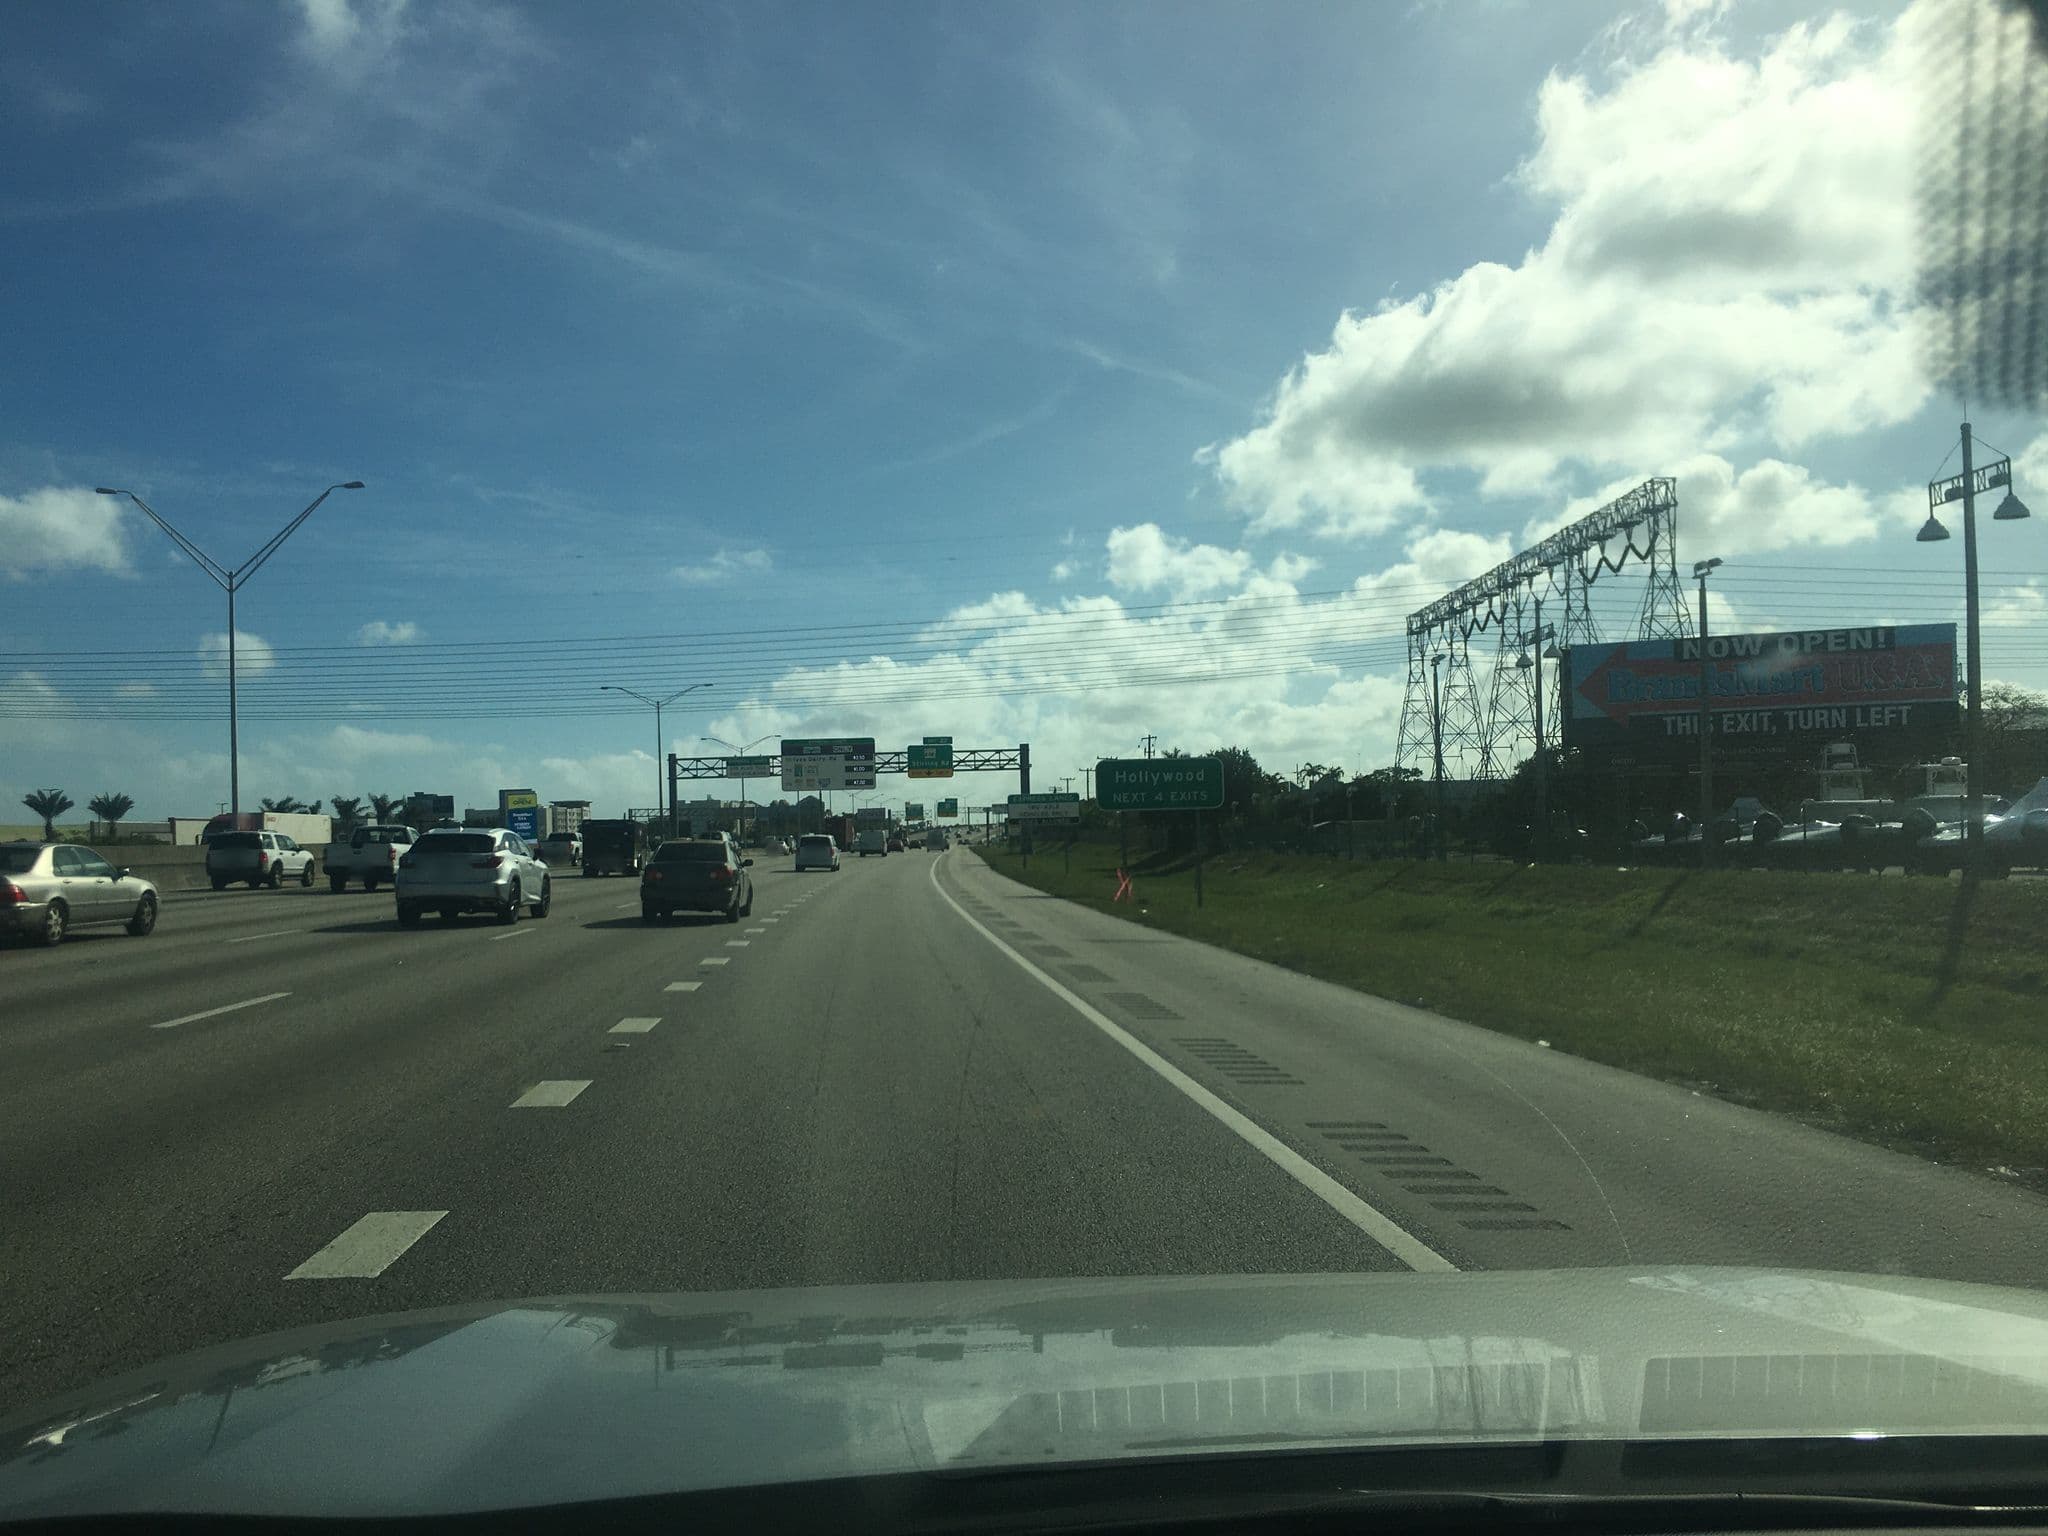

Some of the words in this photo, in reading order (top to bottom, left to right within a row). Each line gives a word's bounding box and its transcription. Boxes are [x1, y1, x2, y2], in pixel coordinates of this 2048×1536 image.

[1682, 635, 1764, 660] NOW
[1777, 629, 1886, 655] OPEN!
[1722, 710, 1776, 736] EXIT,
[1784, 708, 1847, 731] TURN
[1856, 704, 1912, 728] LEFT
[1115, 769, 1205, 786] Hollywood
[1113, 793, 1146, 803] NEXT
[1155, 792, 1164, 801] 4
[1171, 791, 1208, 801] EXITS
